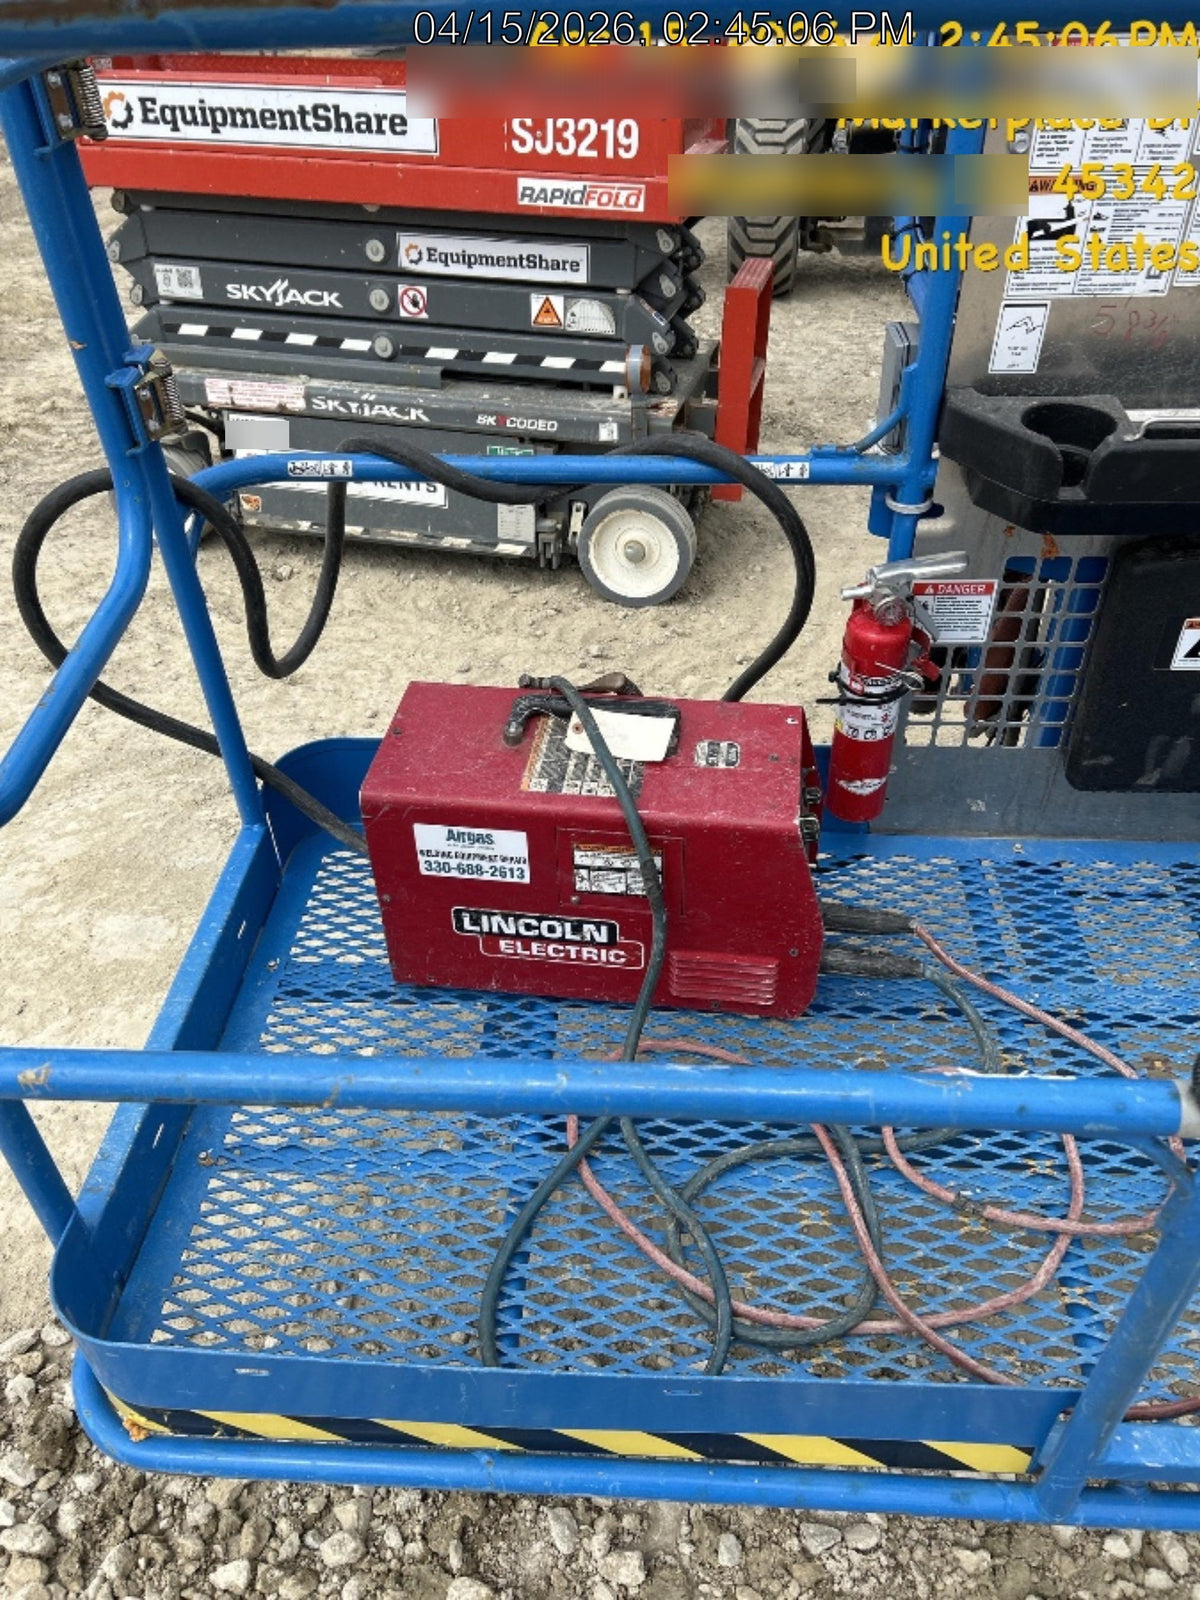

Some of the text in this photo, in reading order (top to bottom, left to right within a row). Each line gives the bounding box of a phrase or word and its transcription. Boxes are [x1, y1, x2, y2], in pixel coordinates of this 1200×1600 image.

[138, 96, 407, 136] EquipmentShare
[511, 118, 640, 159] SJ3219
[426, 247, 580, 273] EquipmentShare
[225, 279, 343, 308] SKYJACK
[312, 393, 431, 423] SKYJACK
[937, 584, 986, 595] DANGER
[446, 829, 495, 845] Airgas
[461, 912, 609, 943] LINCOLN
[499, 940, 628, 964] ELECTRIC
